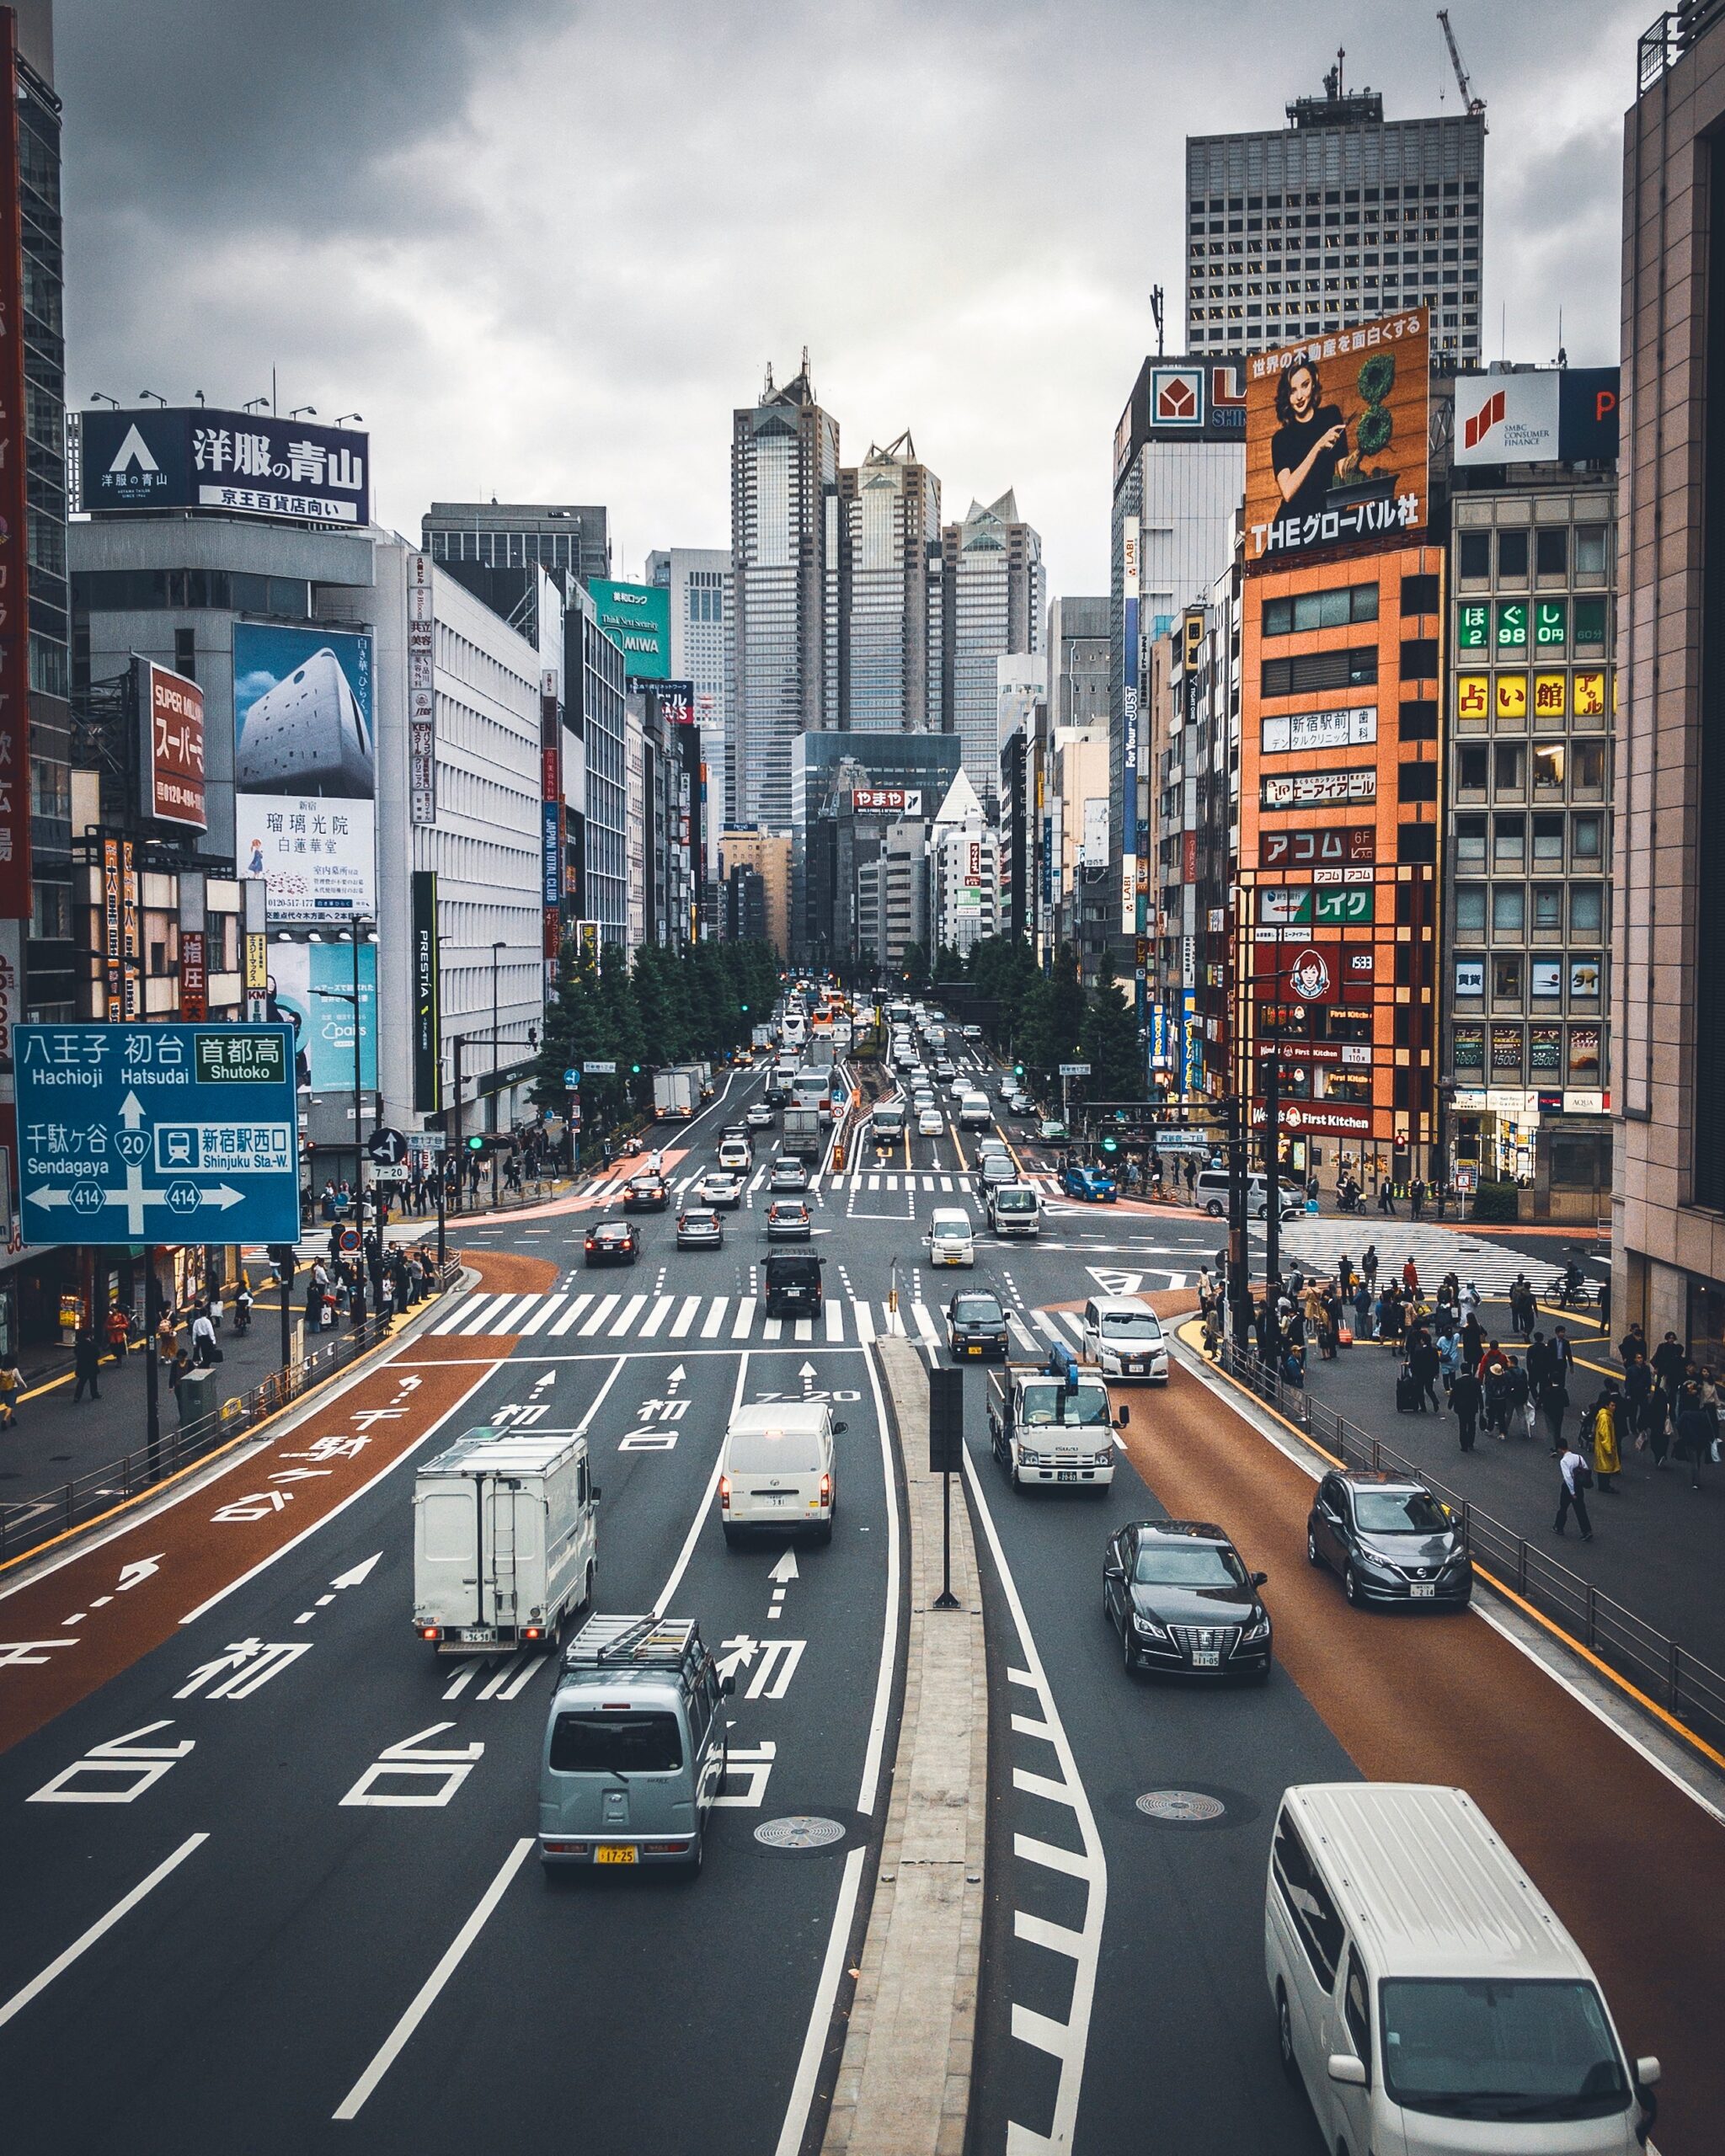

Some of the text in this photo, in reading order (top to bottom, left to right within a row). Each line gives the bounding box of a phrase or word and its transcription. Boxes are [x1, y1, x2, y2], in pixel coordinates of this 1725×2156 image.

[1252, 316, 1421, 379] 世界の不動産を面白くする
[1504, 430, 1550, 439] CONSUMER
[1504, 438, 1541, 446] FINANCE
[192, 427, 363, 491] 洋服の青山
[101, 472, 168, 488] 洋服の青山
[220, 488, 339, 517] 京王百貨店向い
[1251, 492, 1418, 553] THEグローバル社
[612, 591, 648, 605] 美和ロック
[601, 614, 619, 625] Think
[635, 618, 659, 630] Security
[1465, 604, 1560, 627] ほぐし
[411, 621, 431, 632] 共立
[411, 635, 432, 646] 美容
[624, 636, 660, 654] MIWA
[357, 638, 369, 716] 白き華、ひらく。
[155, 684, 183, 715] SUPER
[1125, 686, 1137, 721] JUST
[1461, 682, 1564, 712] 占い館
[413, 723, 432, 732] KEN
[1292, 712, 1347, 734] 新宿駅前
[1358, 711, 1369, 740] 歯科
[1272, 731, 1349, 750] デンタルクリニック
[1125, 748, 1136, 767] For
[856, 791, 902, 807] やまや
[1294, 780, 1375, 800] エーアイアール
[299, 801, 318, 811] 新宿
[266, 812, 350, 835] 瑠璃光院
[278, 837, 338, 854] 白蓮華堂
[1267, 831, 1343, 862] アコム
[1354, 830, 1370, 844] 6F
[546, 818, 558, 902] JAPAN TOTAL CLUB
[1316, 870, 1340, 882] アコム
[1347, 868, 1371, 880] アコム
[268, 899, 314, 907] 0120-517-177
[1315, 891, 1366, 916] レイク
[183, 942, 203, 988] 指圧
[1457, 974, 1482, 986] 賃貸
[248, 990, 266, 1001] KM
[24, 1033, 280, 1065] 八王子 初台 首都高
[1312, 1049, 1338, 1058] Kitchen
[32, 1065, 270, 1089] Hachioji Hatsudai Shutoko
[1302, 1113, 1369, 1129] First Kitchen
[27, 1123, 286, 1155] 千駄ヶ谷 20 新宿駅西口
[27, 1154, 289, 1177] Sendagaya Shinjuku Sta.-W.
[375, 1168, 403, 1177] 7-20
[74, 1188, 197, 1205] 414 414
